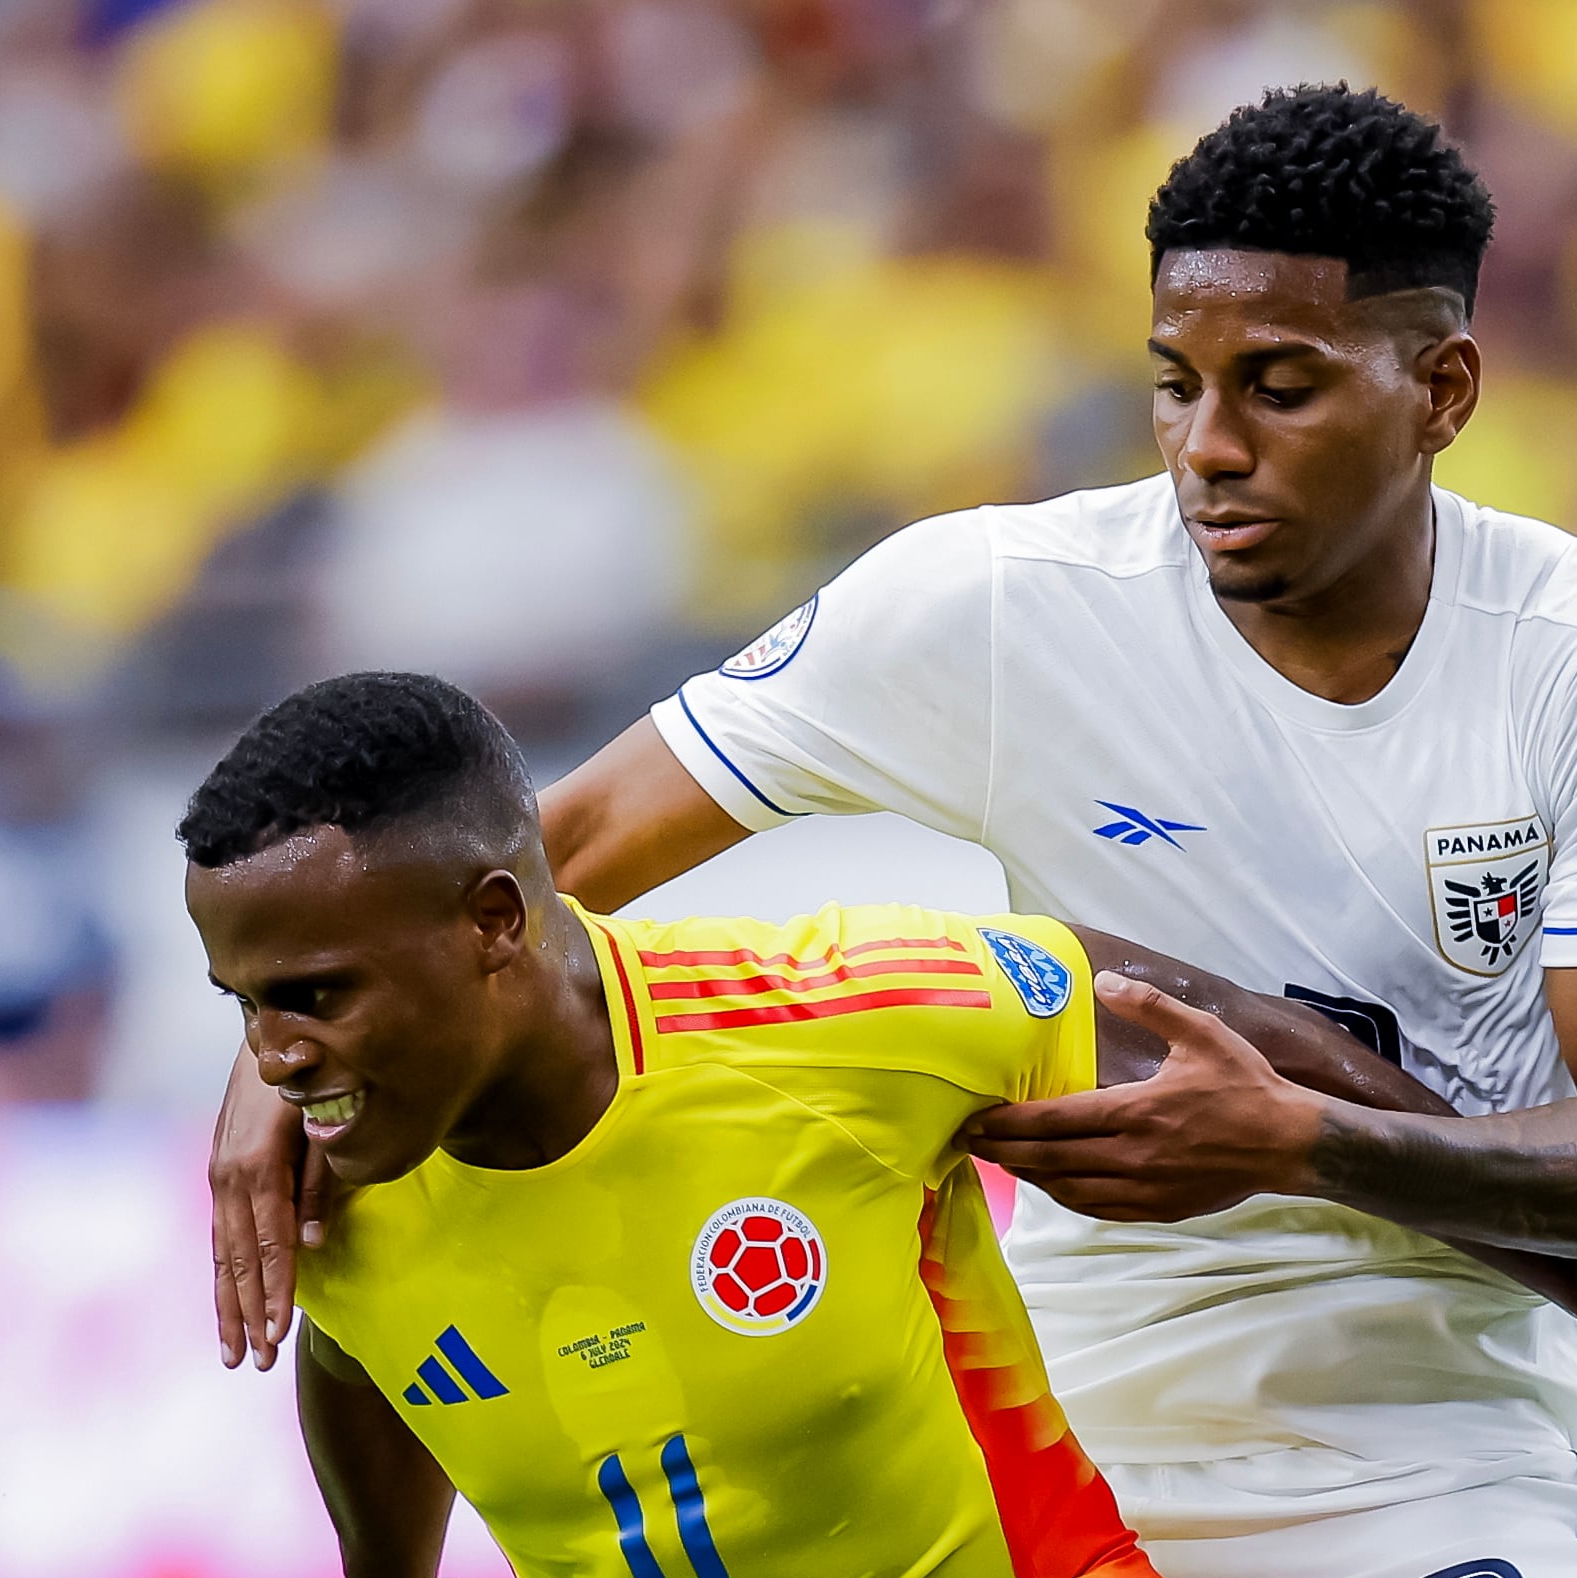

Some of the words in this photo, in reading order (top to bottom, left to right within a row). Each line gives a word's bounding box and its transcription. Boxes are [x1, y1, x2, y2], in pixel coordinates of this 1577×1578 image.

[709, 1203, 765, 1234] COLOMBIANA
[767, 1204, 780, 1215] DE
[780, 1208, 812, 1239] FUTBOL
[558, 1334, 600, 1357] COLOMBIA
[610, 1321, 645, 1338] PANAMA
[580, 1351, 587, 1360] 6
[589, 1344, 607, 1357] JULY
[609, 1338, 631, 1350] 2024
[589, 1348, 630, 1369] GLENDALE
